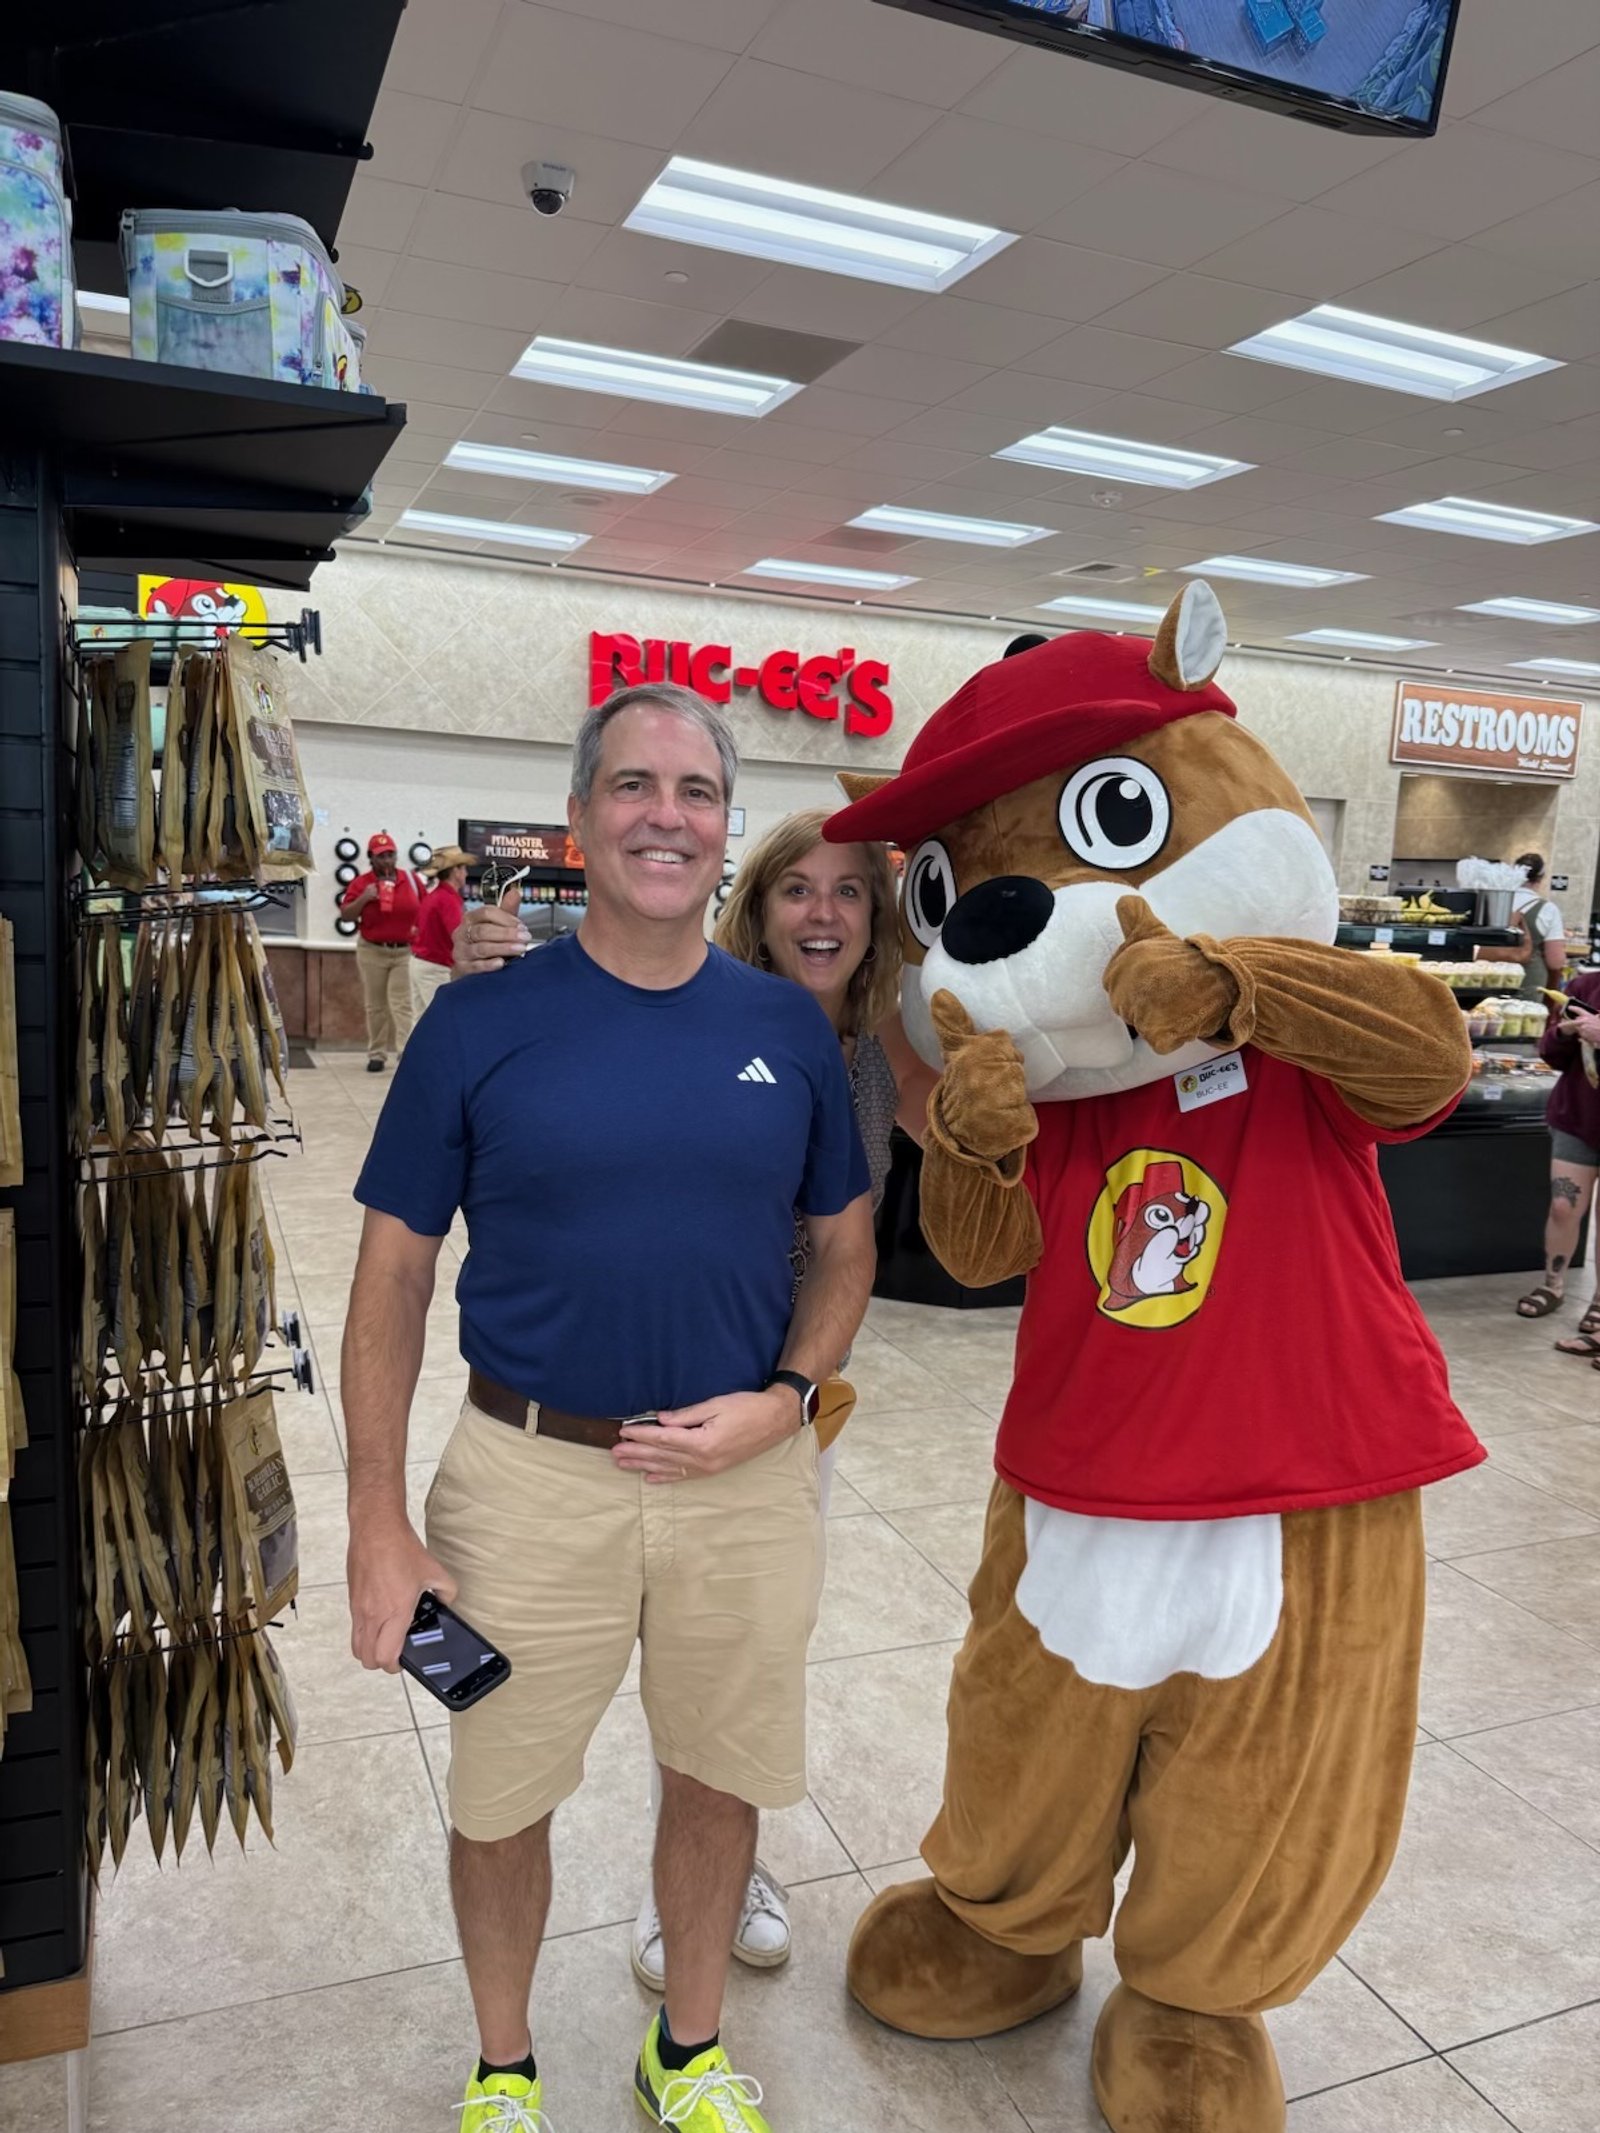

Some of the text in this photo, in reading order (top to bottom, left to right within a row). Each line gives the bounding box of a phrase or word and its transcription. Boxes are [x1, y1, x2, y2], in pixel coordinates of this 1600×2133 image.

[1400, 698, 1577, 759] RESTROOMS
[491, 835, 544, 848] PITMASTER
[485, 845, 550, 860] PULLED PORK
[1196, 1081, 1229, 1099] BUC-EE
[255, 1472, 284, 1501] GARLIC
